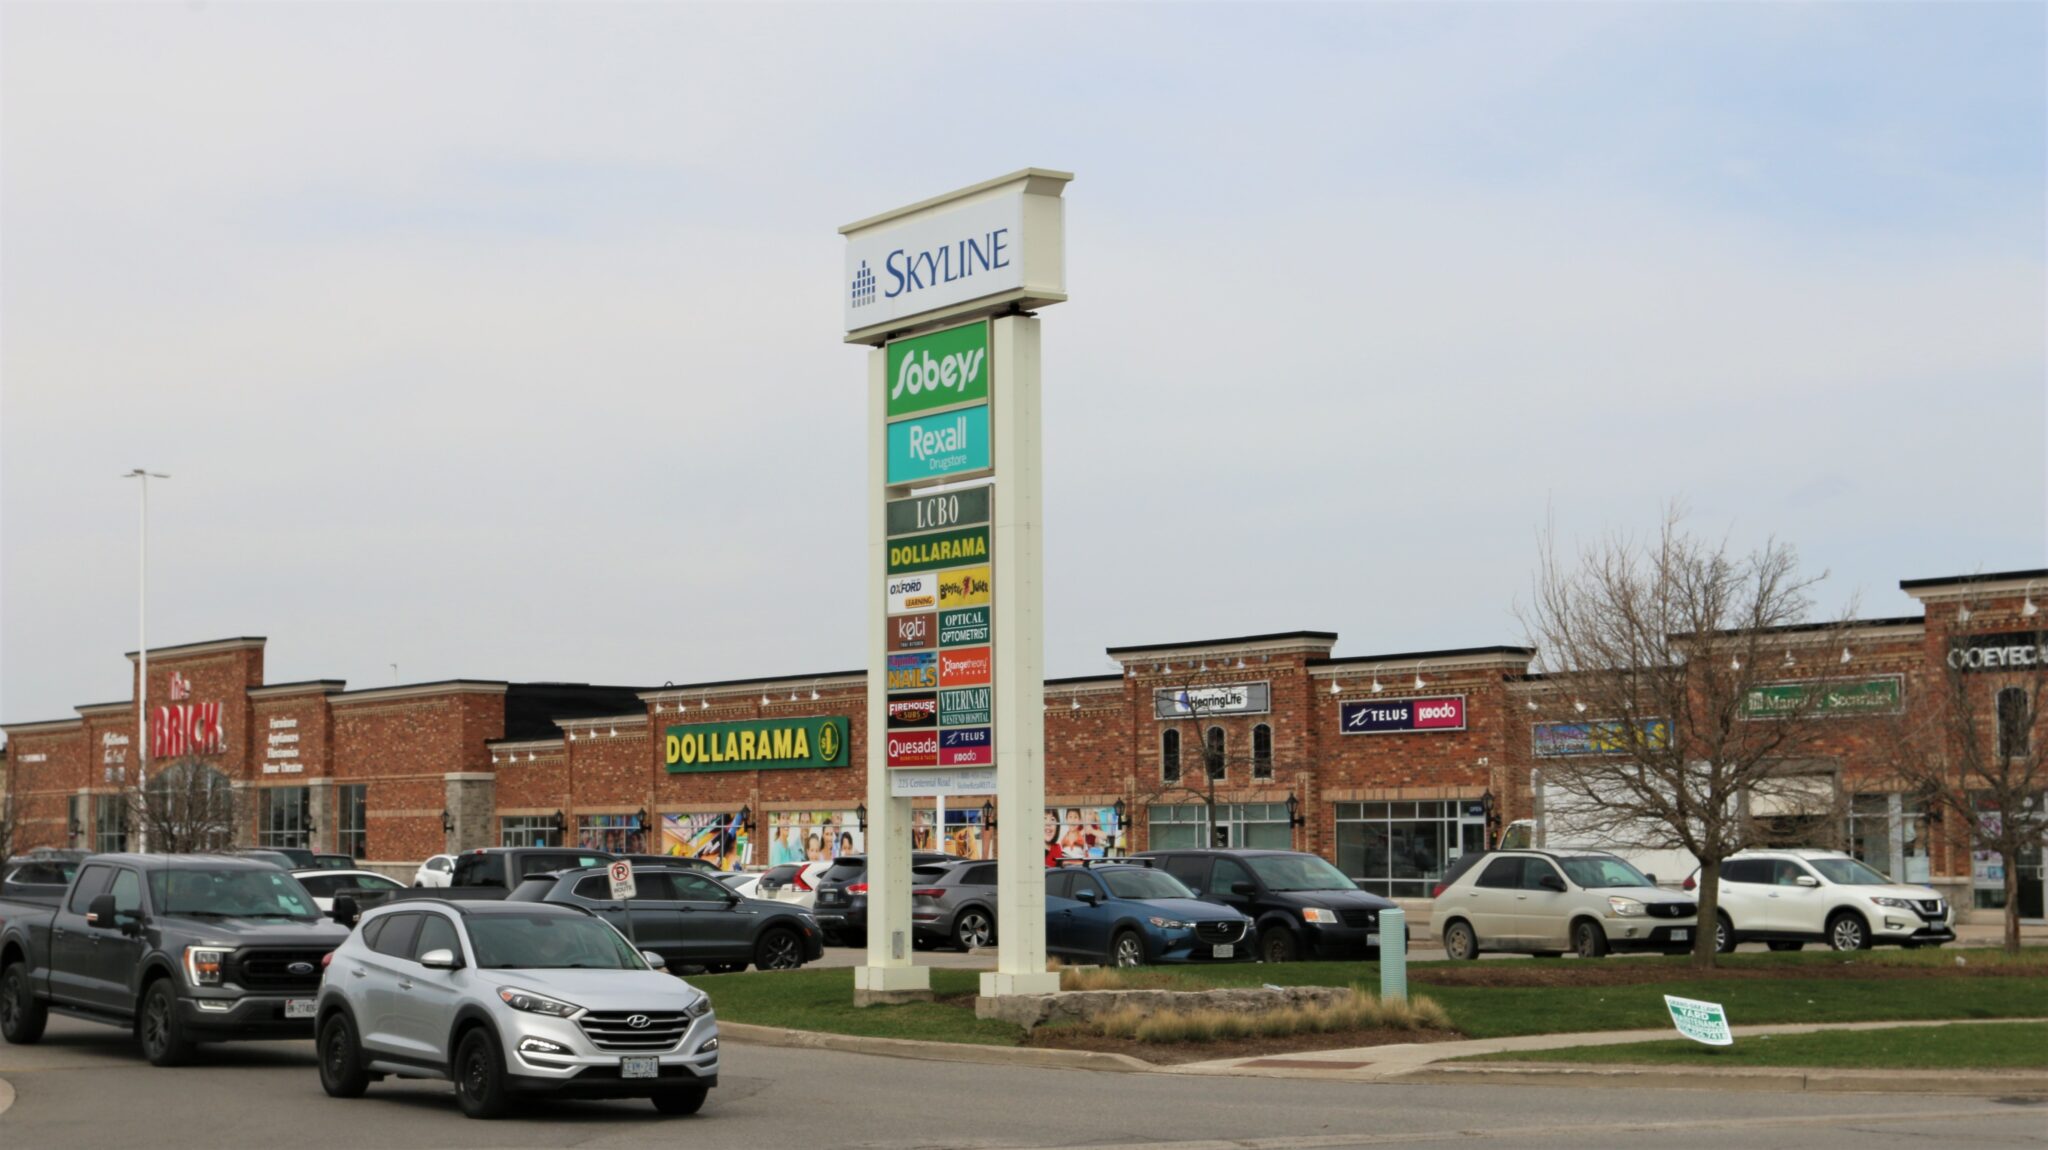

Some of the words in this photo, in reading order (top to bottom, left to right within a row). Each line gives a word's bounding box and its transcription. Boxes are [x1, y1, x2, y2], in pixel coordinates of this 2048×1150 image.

[884, 228, 1010, 298] SKYLINE
[892, 347, 984, 400] Sobeys
[910, 416, 967, 461] Rexall
[930, 454, 967, 470] Drugstore
[917, 495, 959, 528] LCBO
[891, 536, 986, 566] DOLLARAMA
[890, 579, 922, 595] OXFORD
[905, 596, 933, 607] LEARNING
[945, 611, 984, 627] OPTICAL
[941, 627, 988, 643] OPTOMETRIST
[888, 667, 937, 688] NAILS
[889, 701, 936, 716] FIREHOUSE
[941, 689, 990, 711] VETERINARY
[1190, 693, 1242, 708] HearingLife
[965, 712, 989, 723] HOSPITAL
[1371, 709, 1408, 721] TELUS
[152, 701, 224, 758] BRICK
[960, 732, 985, 741] TELUS
[666, 728, 810, 763] DOLLARAMA
[889, 738, 937, 757] Quesada
